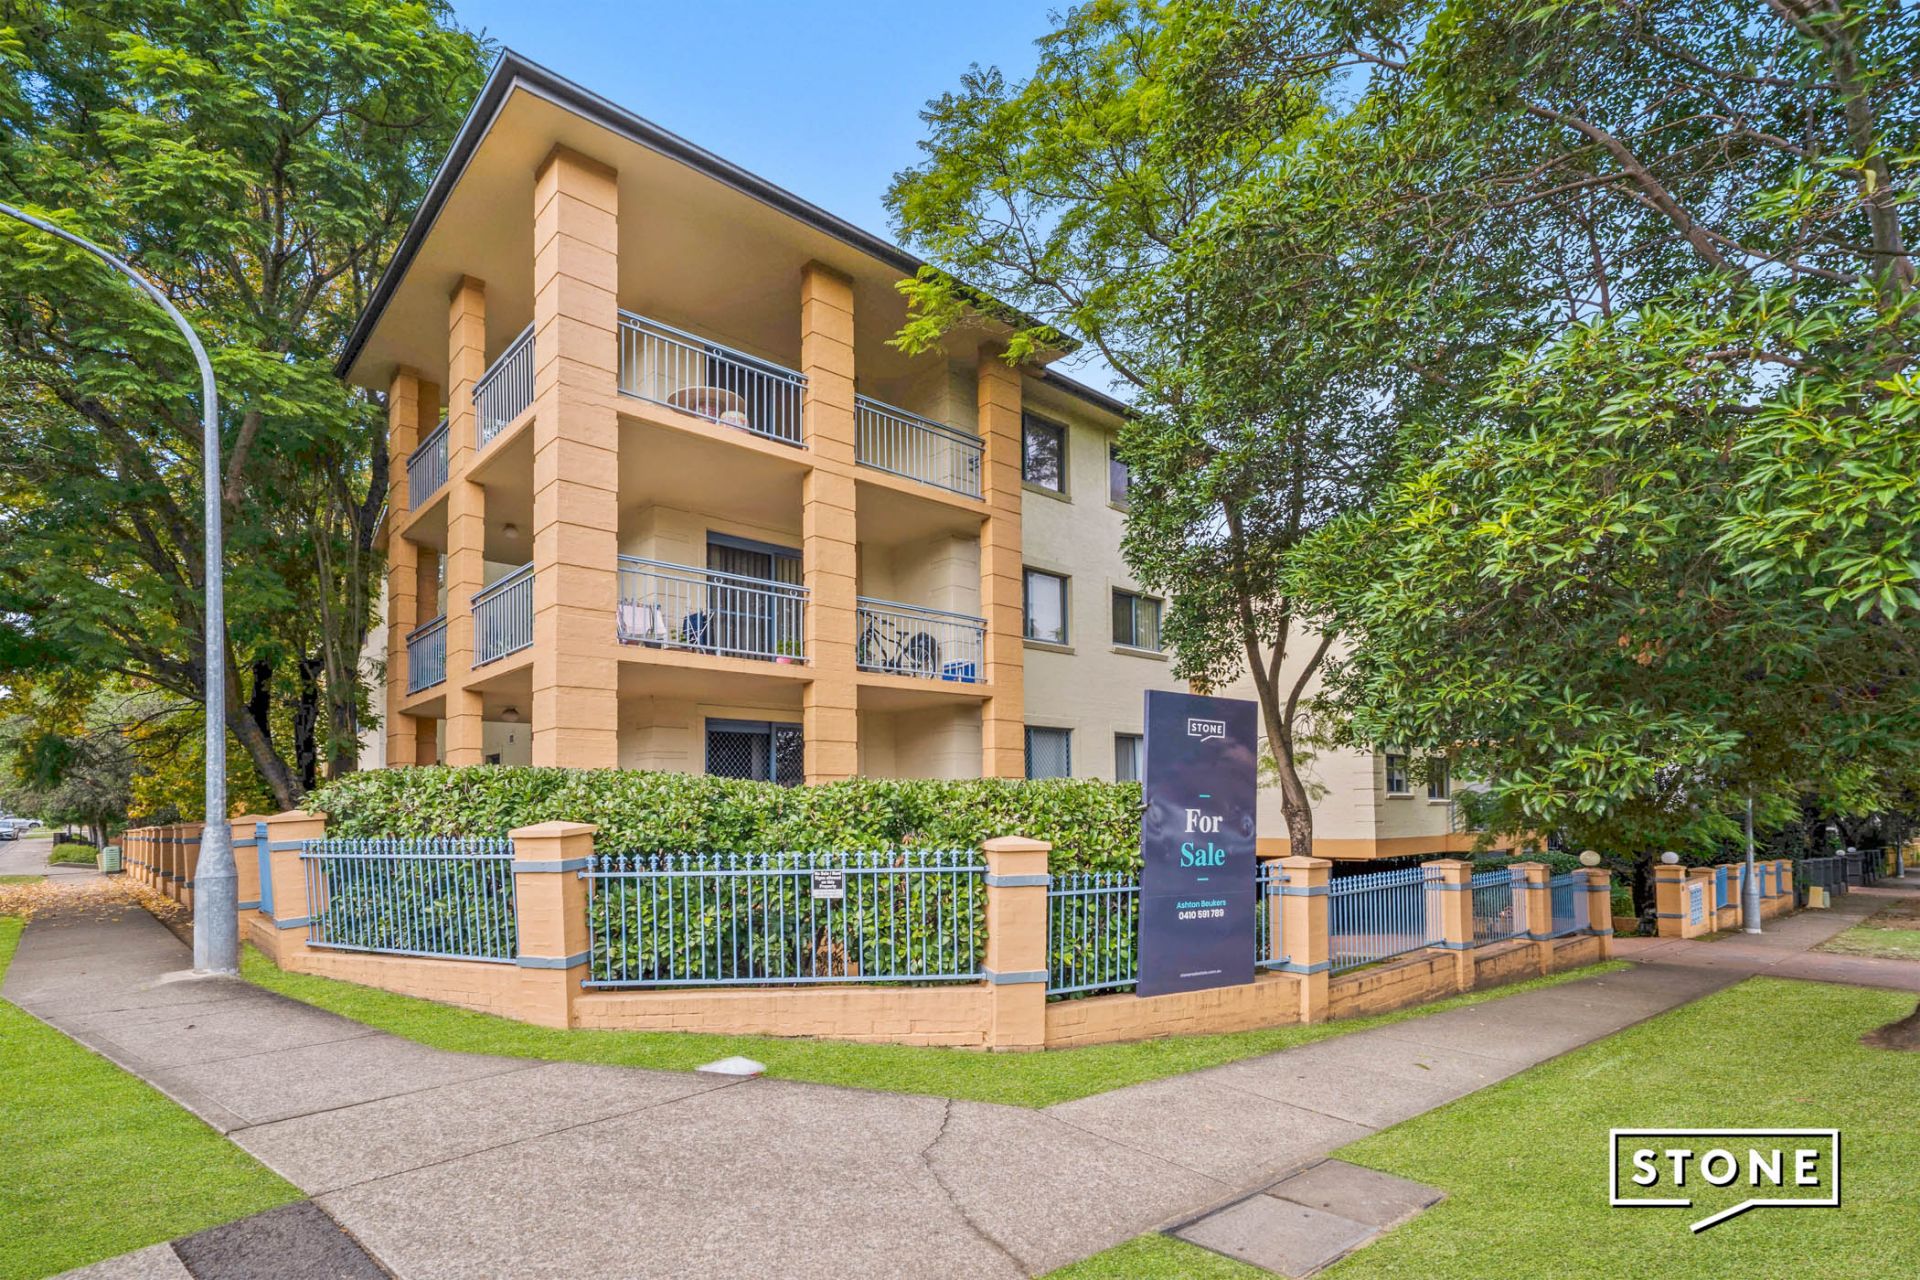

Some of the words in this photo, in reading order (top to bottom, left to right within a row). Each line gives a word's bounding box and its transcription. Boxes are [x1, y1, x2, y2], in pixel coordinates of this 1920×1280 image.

[1191, 723, 1222, 734] STONE
[1185, 808, 1223, 833] For
[1181, 842, 1225, 867] Sale
[1176, 901, 1200, 909] Ashton
[1179, 911, 1196, 920] 0410
